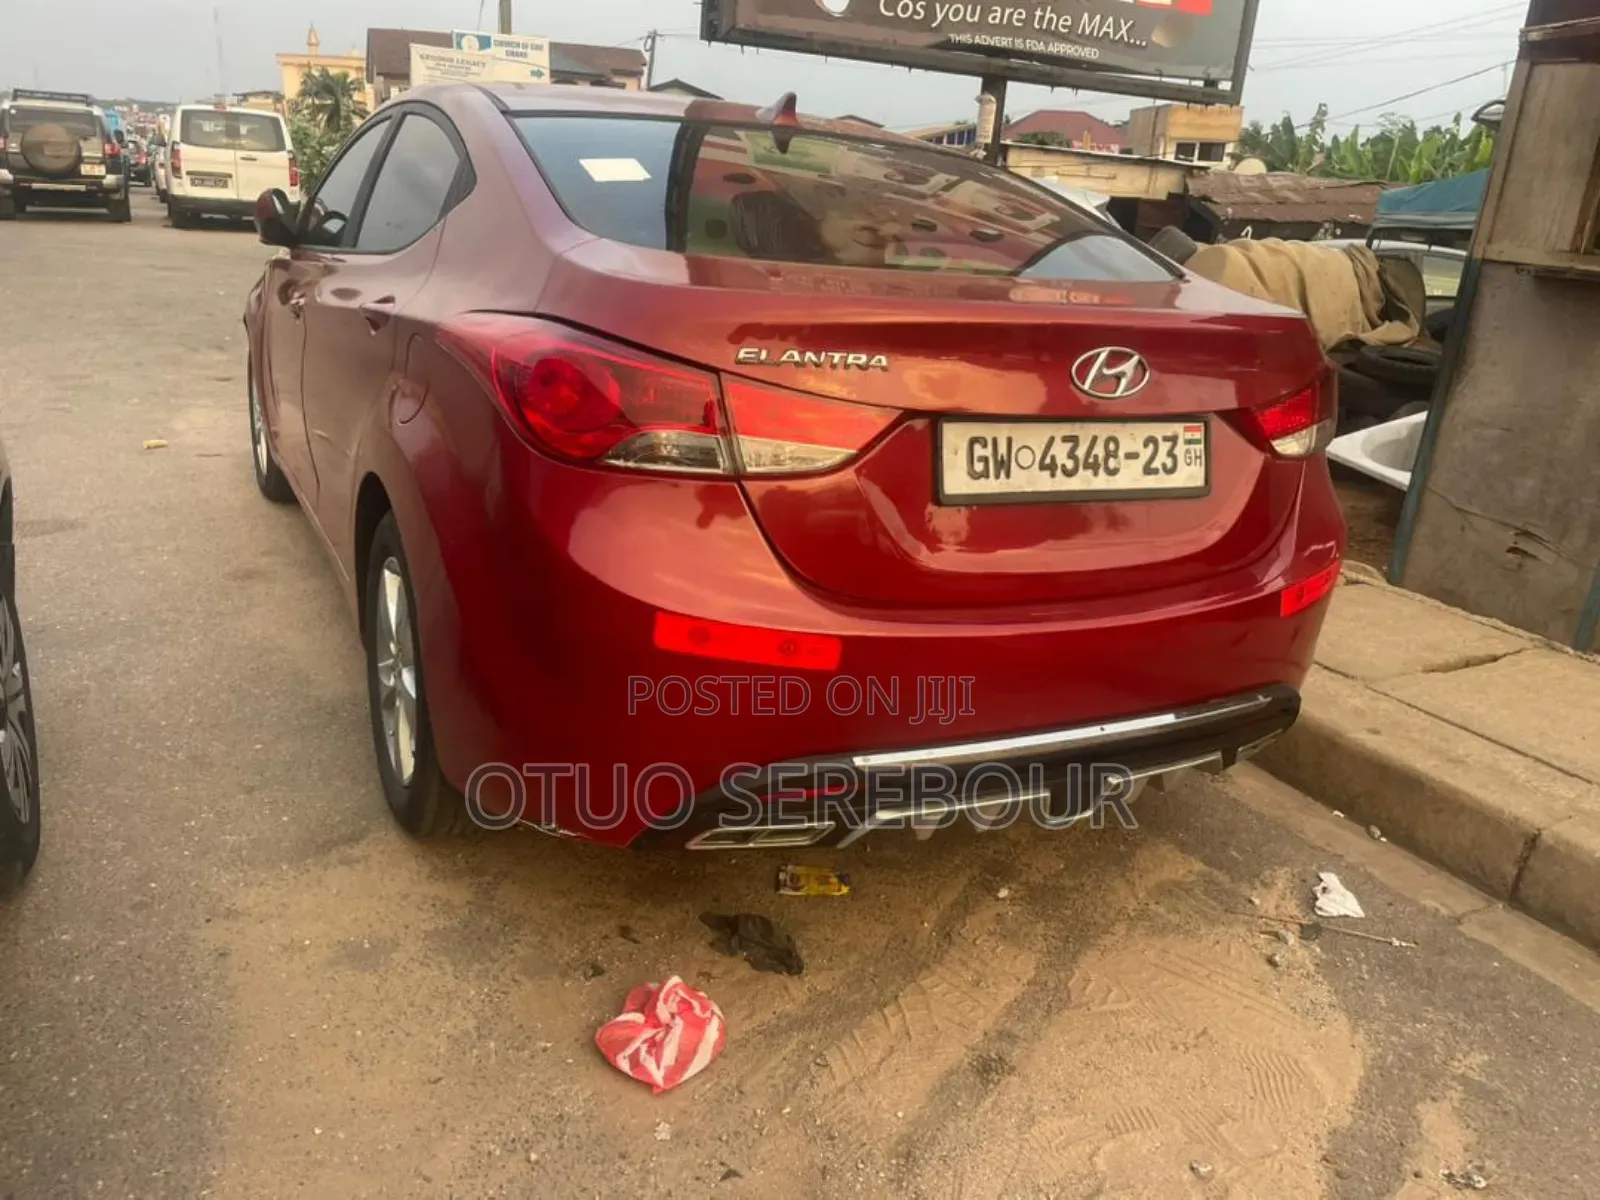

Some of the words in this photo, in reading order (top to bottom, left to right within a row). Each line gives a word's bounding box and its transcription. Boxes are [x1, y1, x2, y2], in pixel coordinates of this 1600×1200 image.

[879, 0, 926, 20] Cos
[931, 2, 981, 28] you
[987, 7, 1026, 27] are
[1033, 6, 1072, 33] the
[1077, 12, 1148, 47] MAX...
[948, 33, 973, 44] THIS
[974, 35, 1013, 48] ADVERT
[1014, 37, 1024, 49] IS
[1026, 39, 1046, 51] FDA
[1047, 42, 1100, 59] APPROVED
[735, 347, 889, 372] ELANTRA
[966, 436, 1013, 480] GW
[1038, 434, 1179, 479] 4348-23
[1184, 447, 1203, 467] GH
